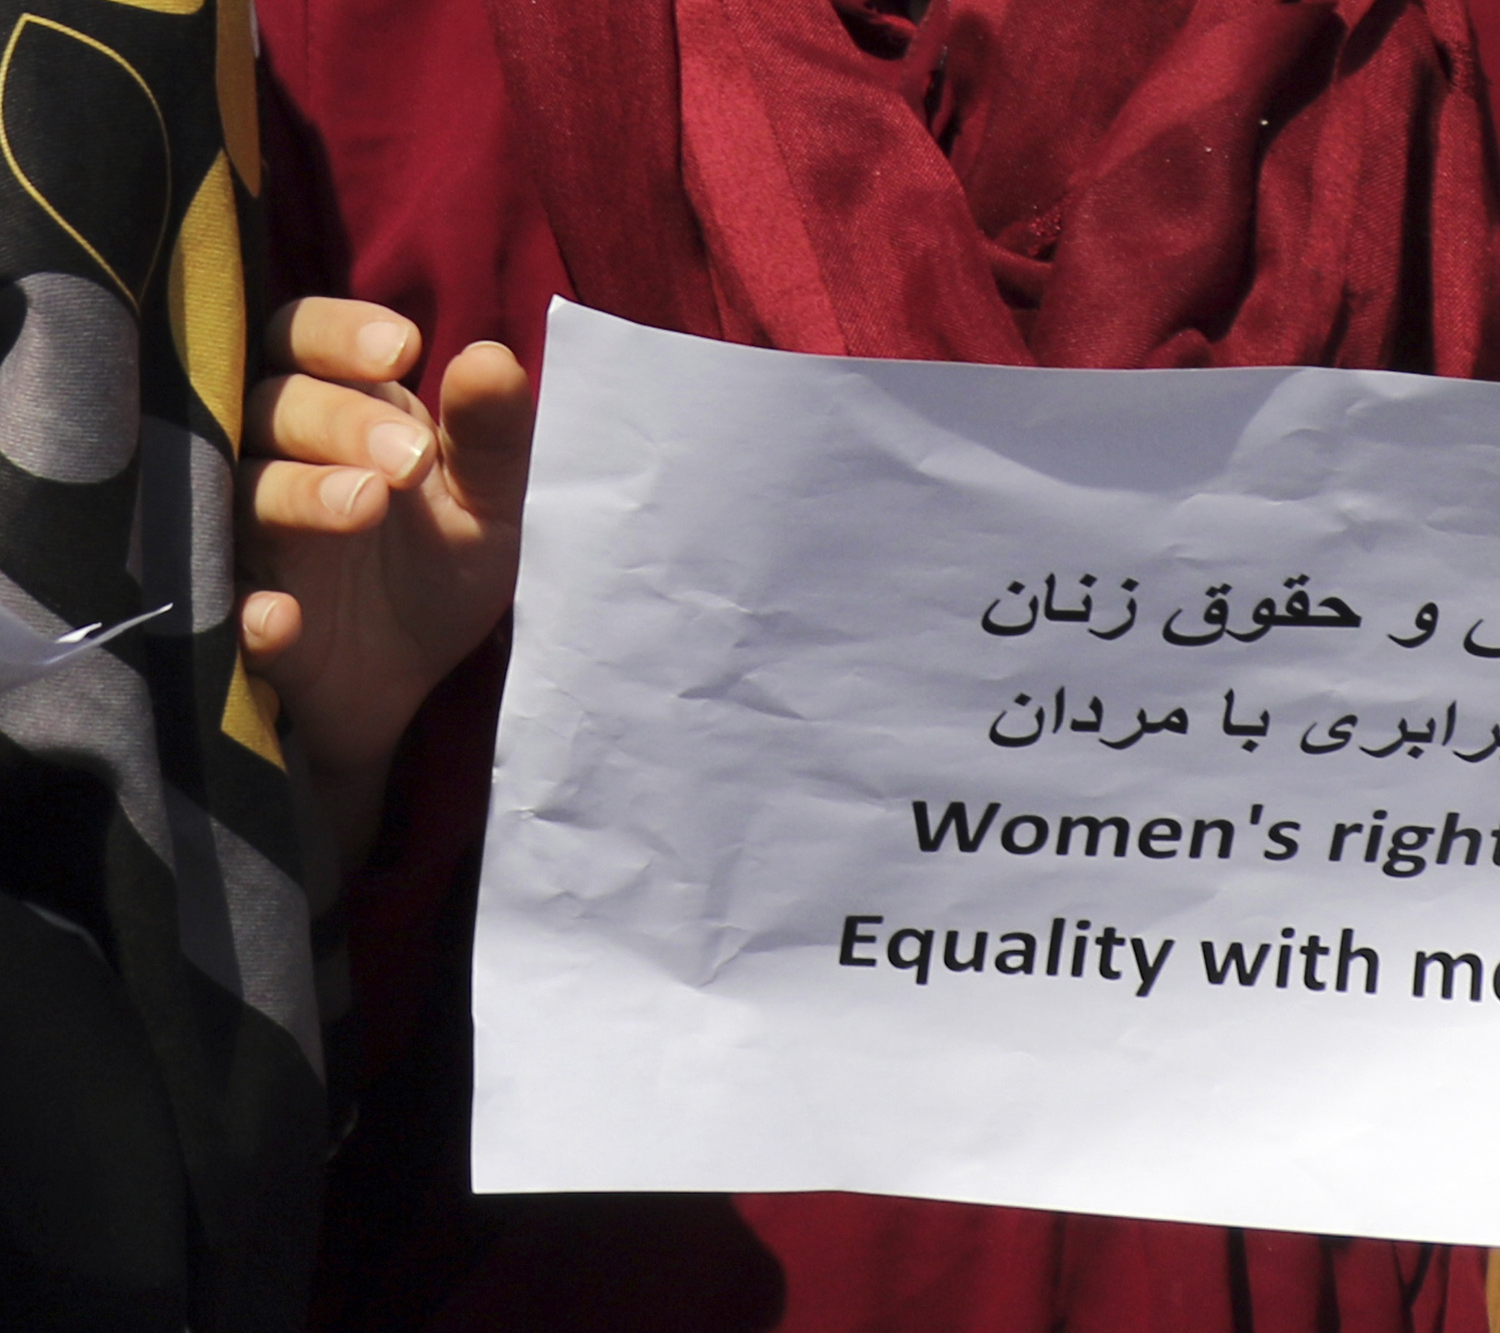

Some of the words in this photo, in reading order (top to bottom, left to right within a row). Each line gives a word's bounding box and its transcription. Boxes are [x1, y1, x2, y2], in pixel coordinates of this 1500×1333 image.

[981, 573, 1139, 640] زنان
[1162, 574, 1361, 646] حقوق
[1388, 602, 1438, 648] و
[989, 686, 1188, 750] مردان
[1223, 689, 1270, 752] با
[912, 801, 1300, 860] Women's
[839, 915, 1174, 997] Equality
[1201, 927, 1378, 994] with
